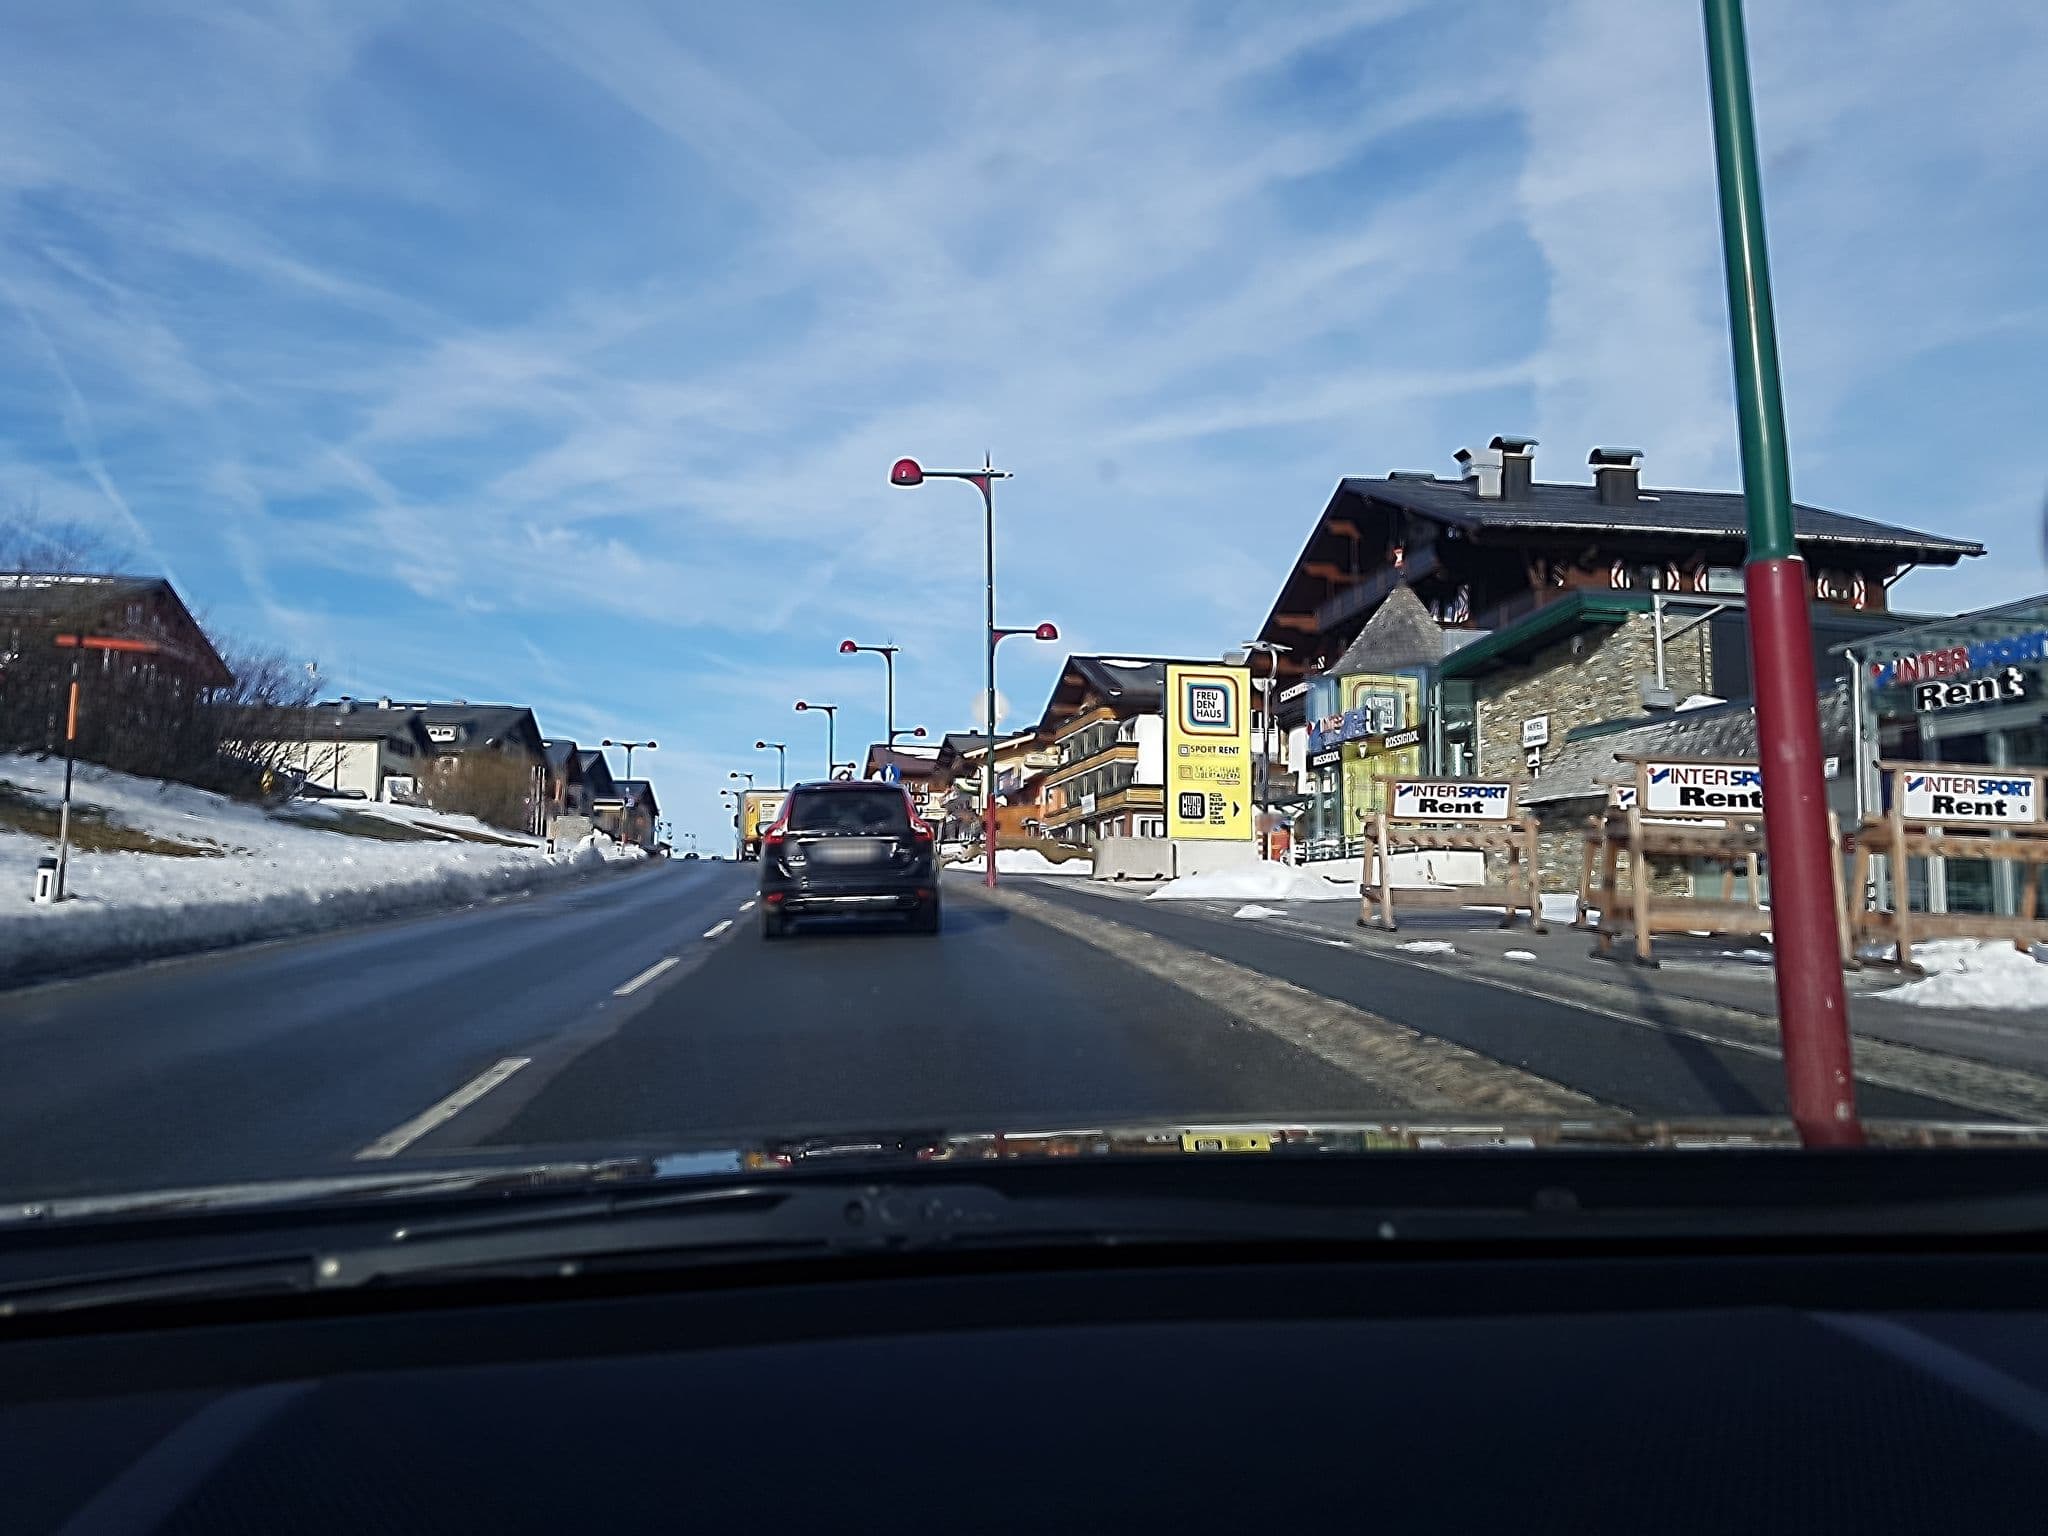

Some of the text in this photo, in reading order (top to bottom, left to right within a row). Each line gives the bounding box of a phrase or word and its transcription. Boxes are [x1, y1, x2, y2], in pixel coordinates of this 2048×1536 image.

[1196, 691, 1218, 701] FREU
[1915, 665, 2025, 712] Rent
[1196, 700, 1216, 709] DEN
[1196, 709, 1222, 718] HAUS
[1385, 730, 1420, 748] ROSSIGNOL
[1190, 745, 1240, 754] SPORT RENT
[1413, 785, 1507, 799] INTERSPORT
[1924, 776, 2032, 797] INTERSPORT
[1679, 786, 1763, 808] Rent
[1418, 798, 1484, 814] Rent
[1932, 795, 2007, 816] Rent
